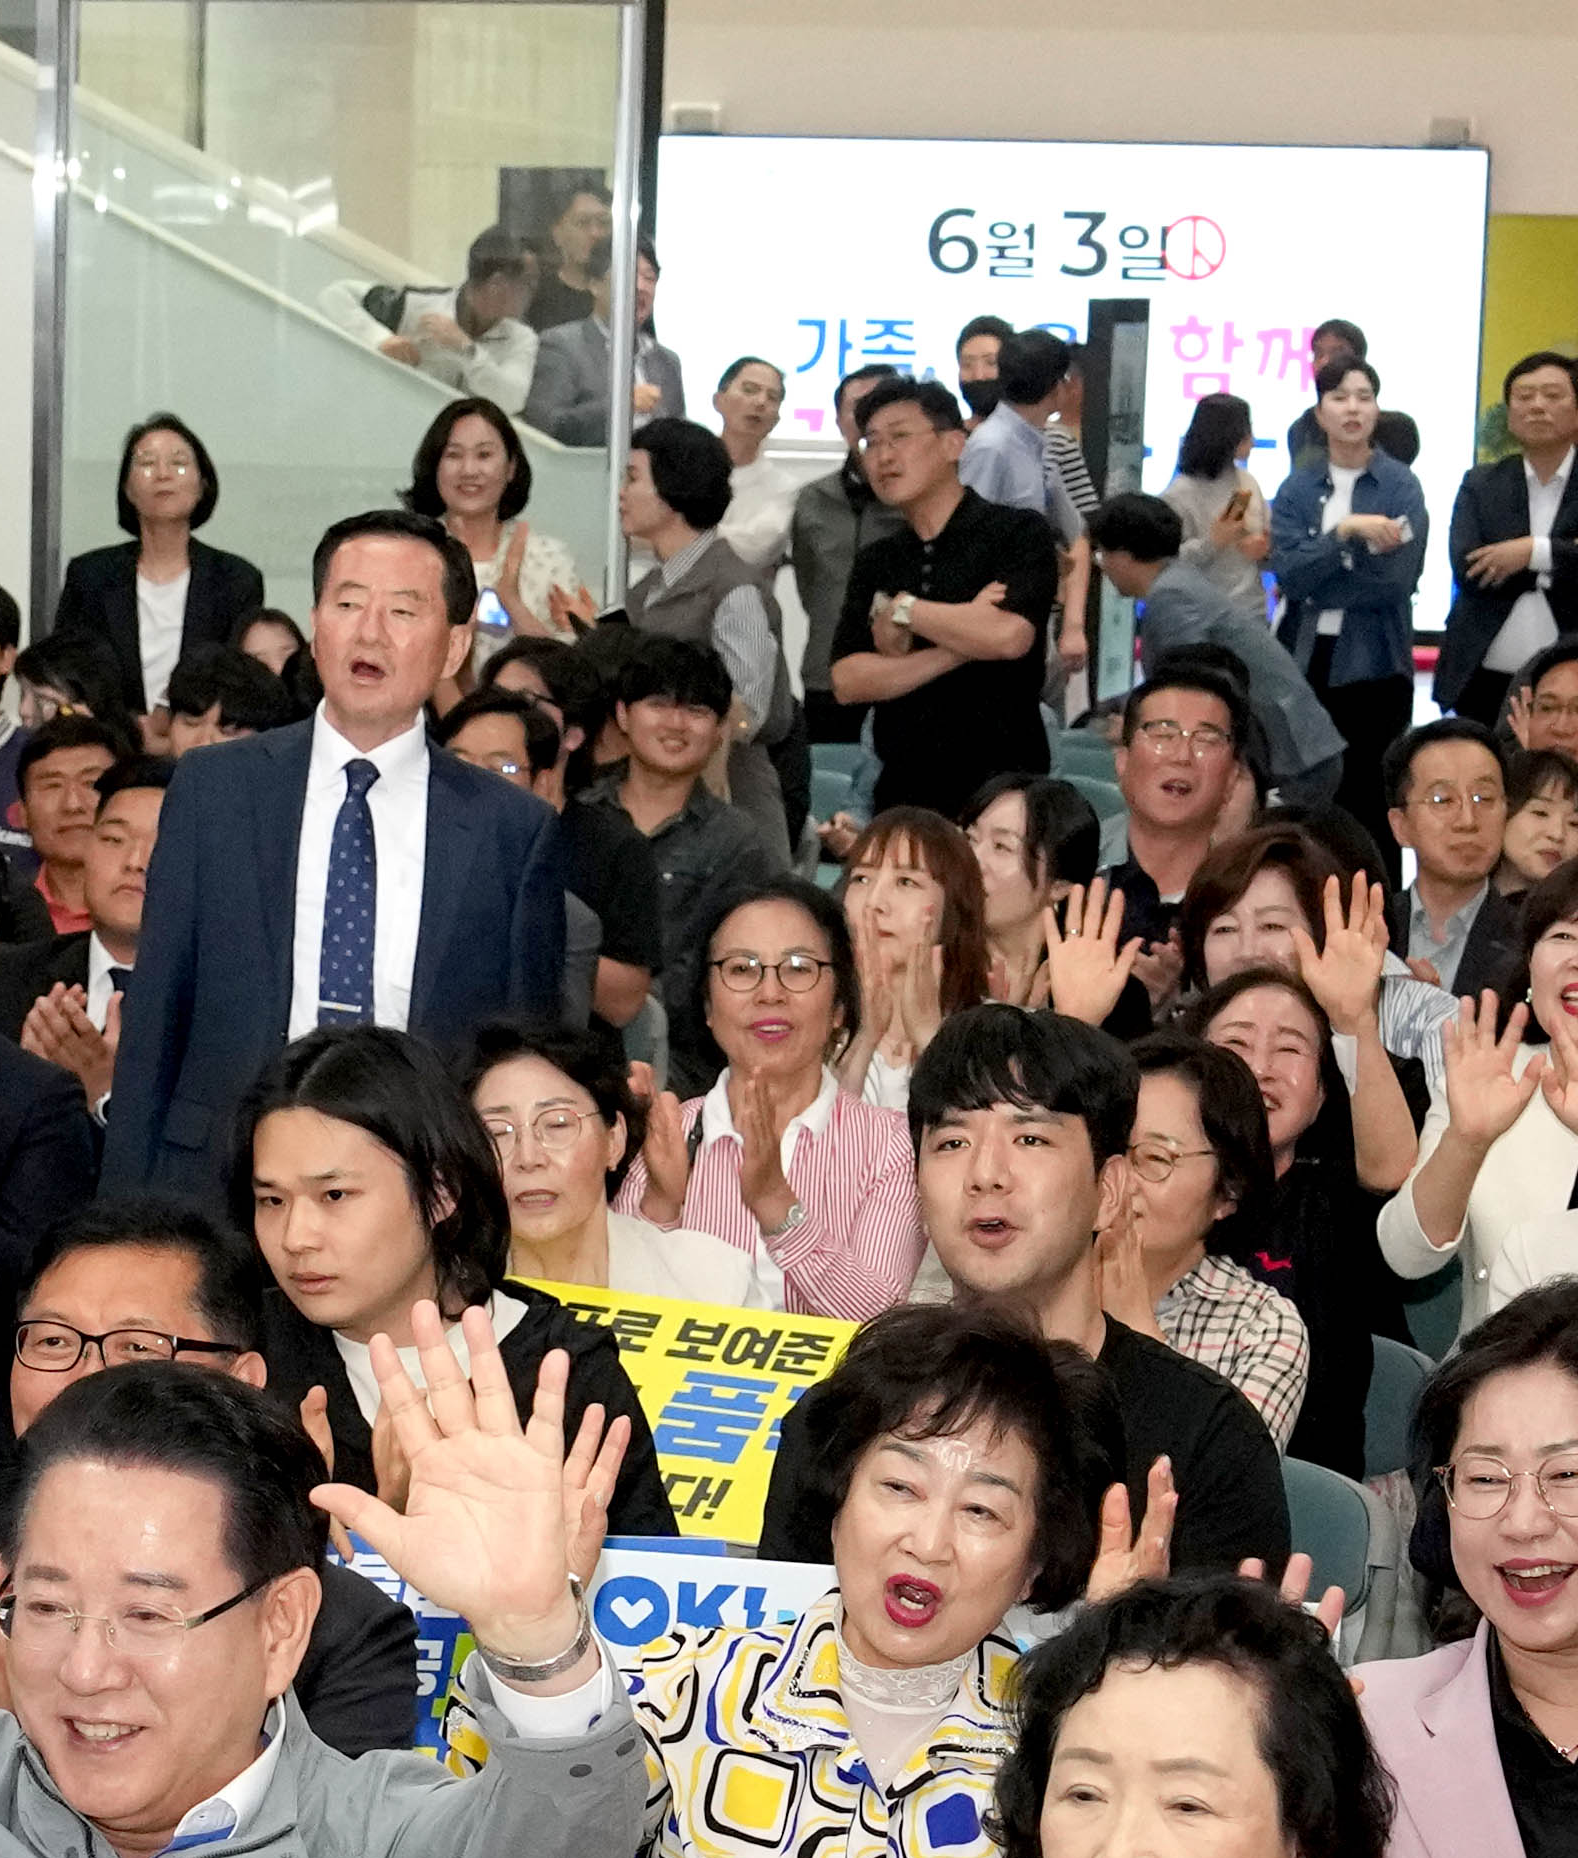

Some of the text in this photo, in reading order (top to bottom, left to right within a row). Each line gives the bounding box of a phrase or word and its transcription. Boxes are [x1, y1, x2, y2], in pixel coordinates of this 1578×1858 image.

[928, 208, 1168, 281] 6월 3일
[664, 1318, 835, 1377] 보여준
